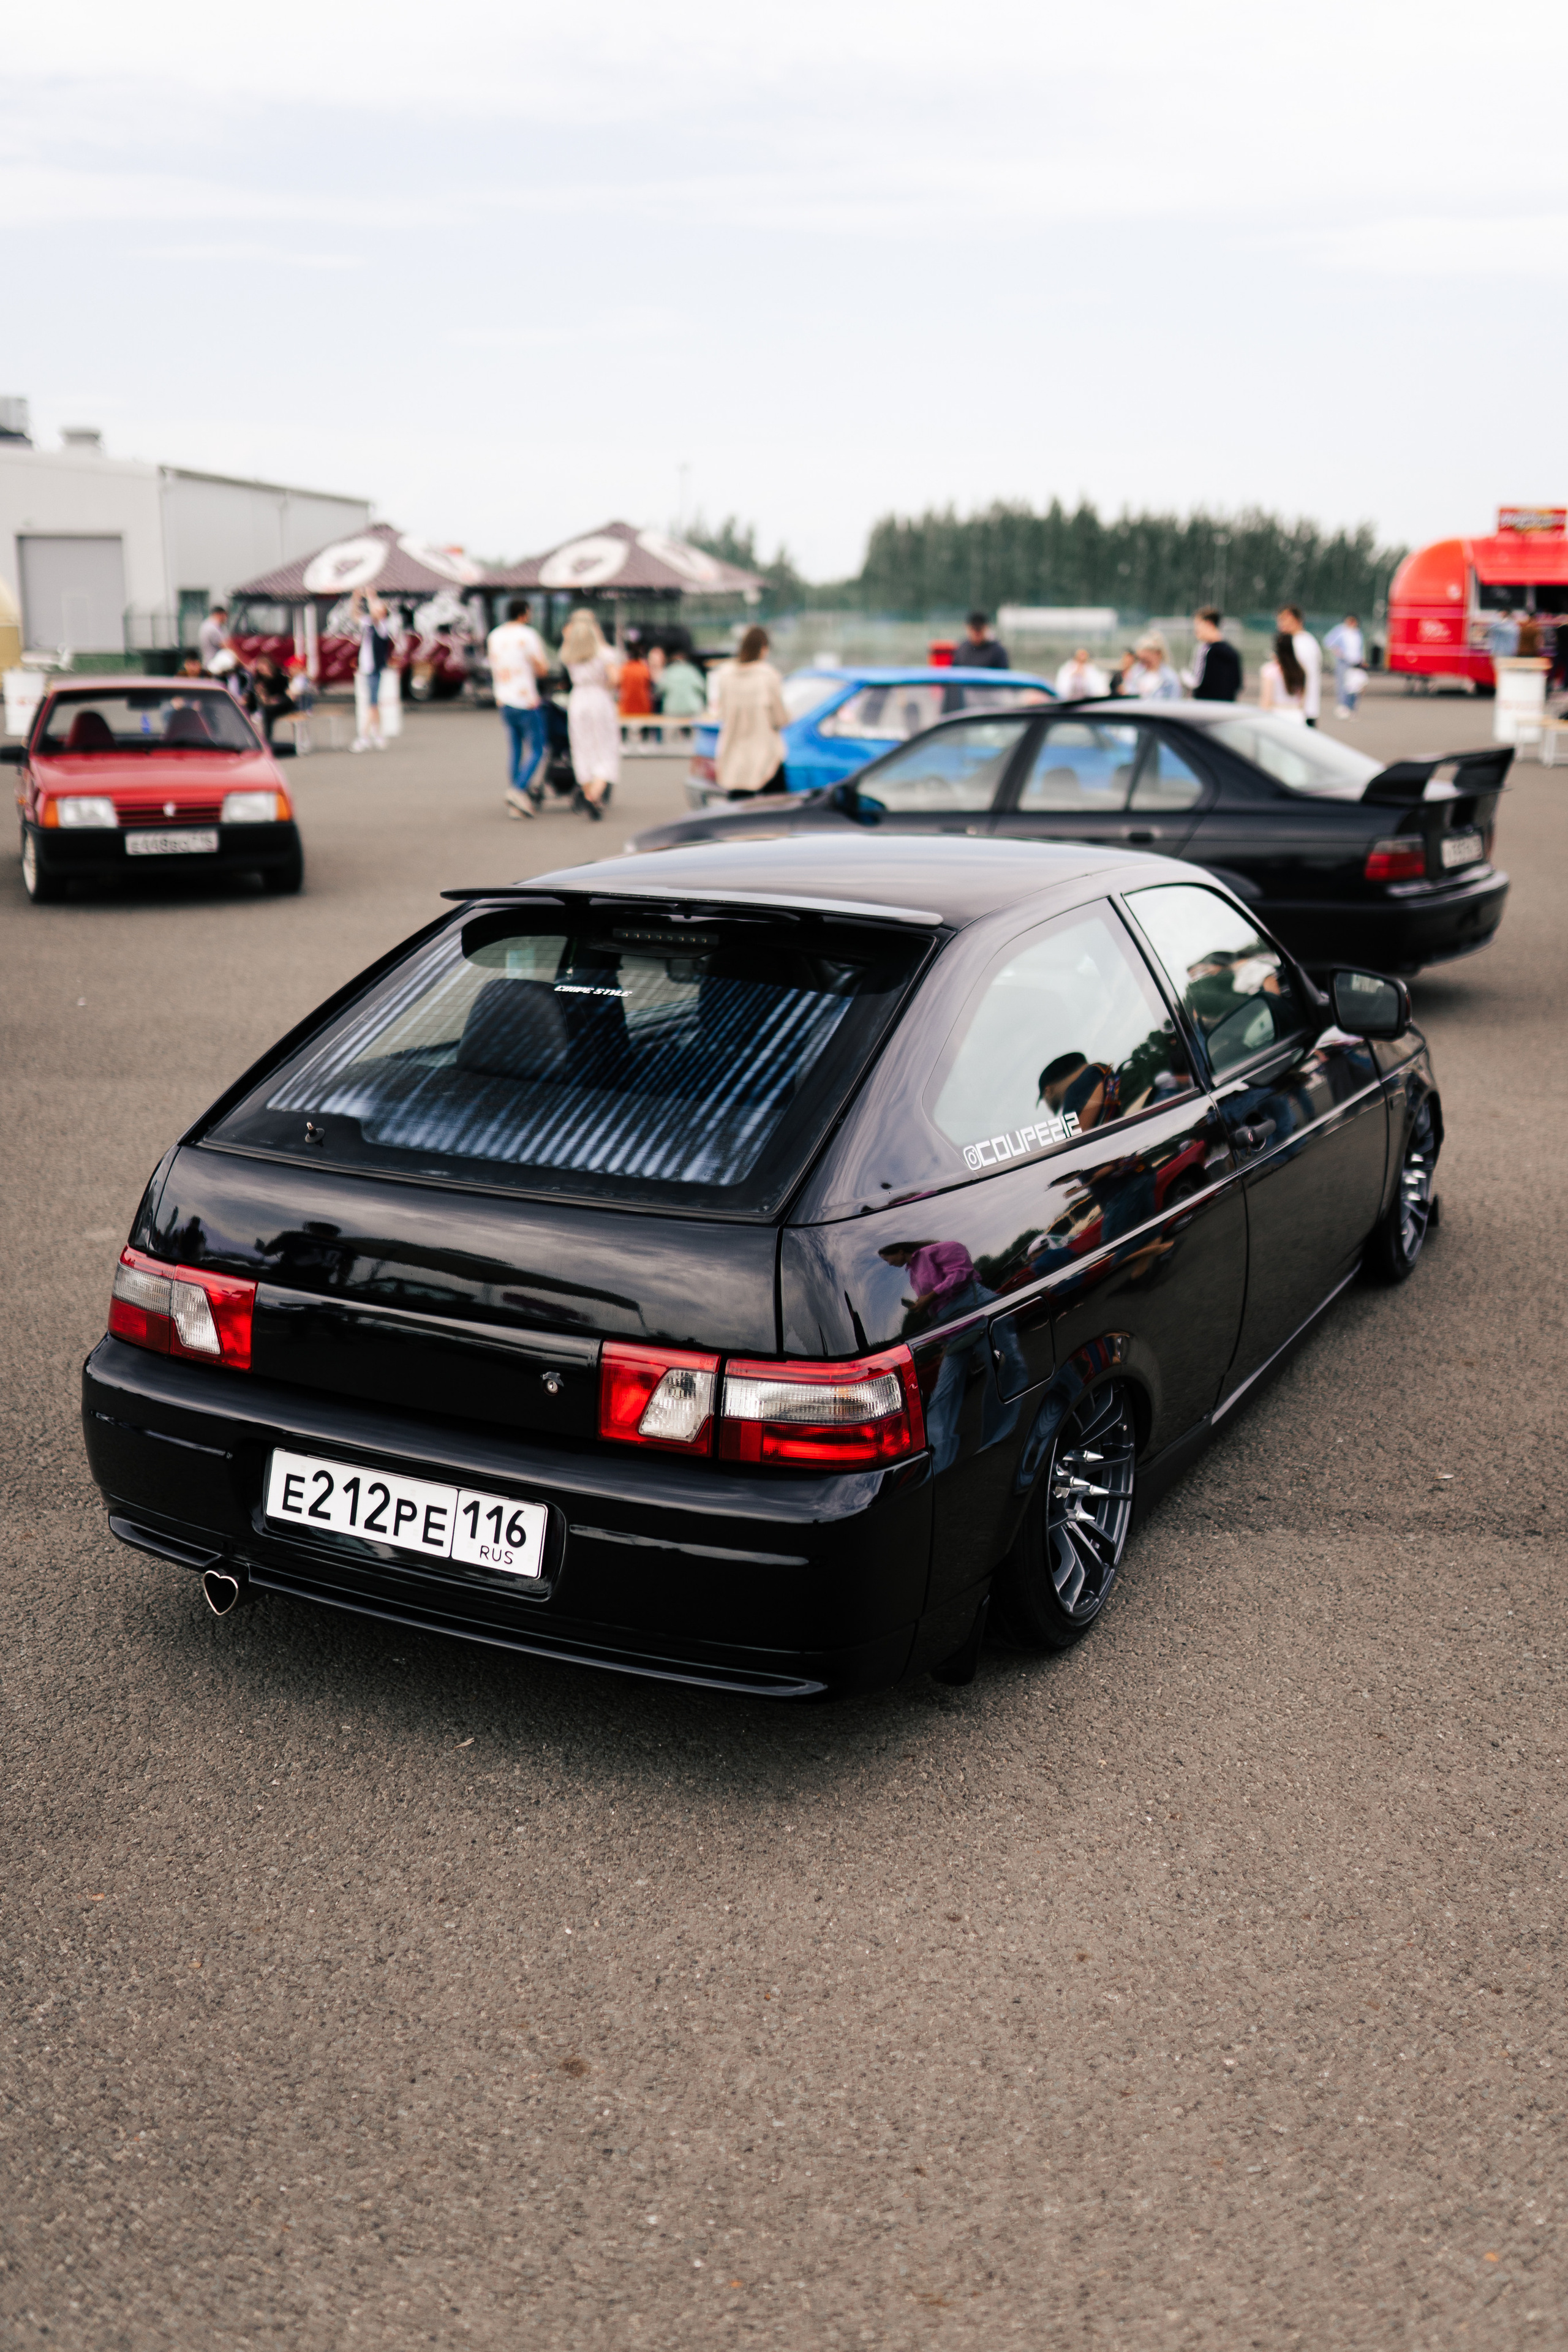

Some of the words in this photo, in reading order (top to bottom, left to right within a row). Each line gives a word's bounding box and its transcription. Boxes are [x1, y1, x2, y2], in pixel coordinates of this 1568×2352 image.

[593, 989, 633, 997] STYLE
[282, 1470, 447, 1547] E212PE
[462, 1501, 527, 1548] 116
[480, 1545, 514, 1565] RUS
